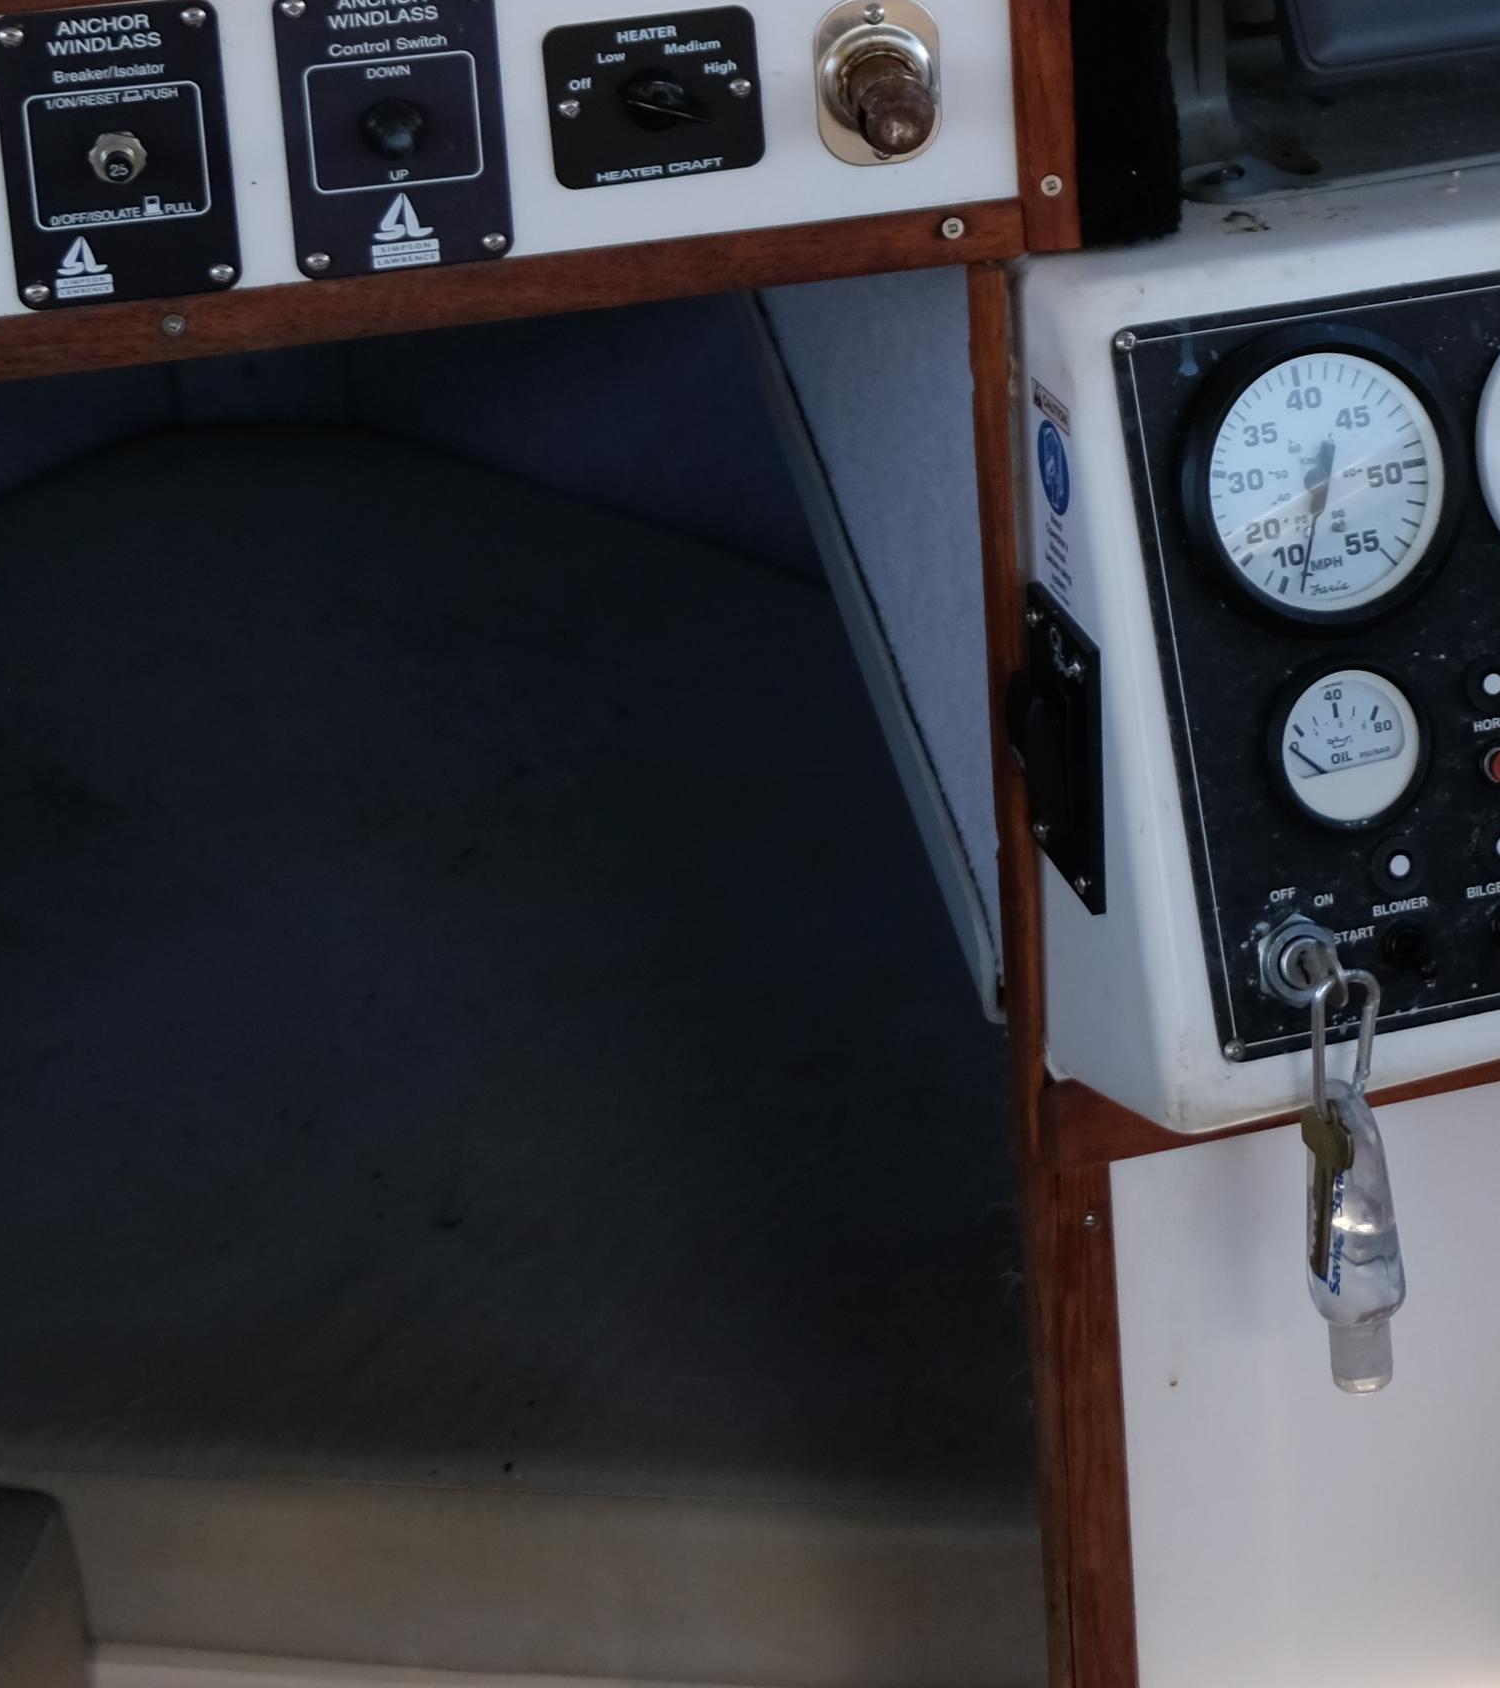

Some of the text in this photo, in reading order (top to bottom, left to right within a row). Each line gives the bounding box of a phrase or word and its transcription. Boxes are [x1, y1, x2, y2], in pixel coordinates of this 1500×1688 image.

[56, 14, 150, 36] ANCHOR
[328, 5, 439, 30] WINDLASS
[46, 32, 162, 56] WINDLASS
[616, 25, 678, 44] HEATER
[328, 34, 448, 57] Control Switch
[664, 39, 721, 55] Medium
[596, 52, 626, 64] Low
[704, 60, 737, 75] High
[53, 62, 165, 84] Breaker/Isolator
[366, 65, 411, 80] DOWN
[143, 87, 179, 100] PUSH
[568, 77, 592, 91] Off
[109, 164, 128, 177] 25
[389, 169, 409, 181] UP
[596, 157, 723, 183] HEATER CRAFT
[164, 202, 197, 214] PULL
[377, 254, 436, 266] LAWRENCE
[1286, 387, 1322, 411] 40
[1336, 405, 1371, 430] 45
[1242, 422, 1278, 447] 35
[1228, 468, 1263, 494] 30
[1367, 462, 1403, 488] 50
[1245, 518, 1280, 544] 20
[1345, 529, 1379, 555] 55
[1272, 543, 1305, 568] 10
[1311, 556, 1343, 572] MPH
[1323, 688, 1343, 701] 40
[1373, 719, 1392, 733] 80
[1331, 752, 1353, 765] OIL
[1270, 887, 1297, 902] OFF
[1314, 893, 1334, 907] ON
[1372, 896, 1429, 917] BLOWER
[1333, 925, 1375, 944] START
